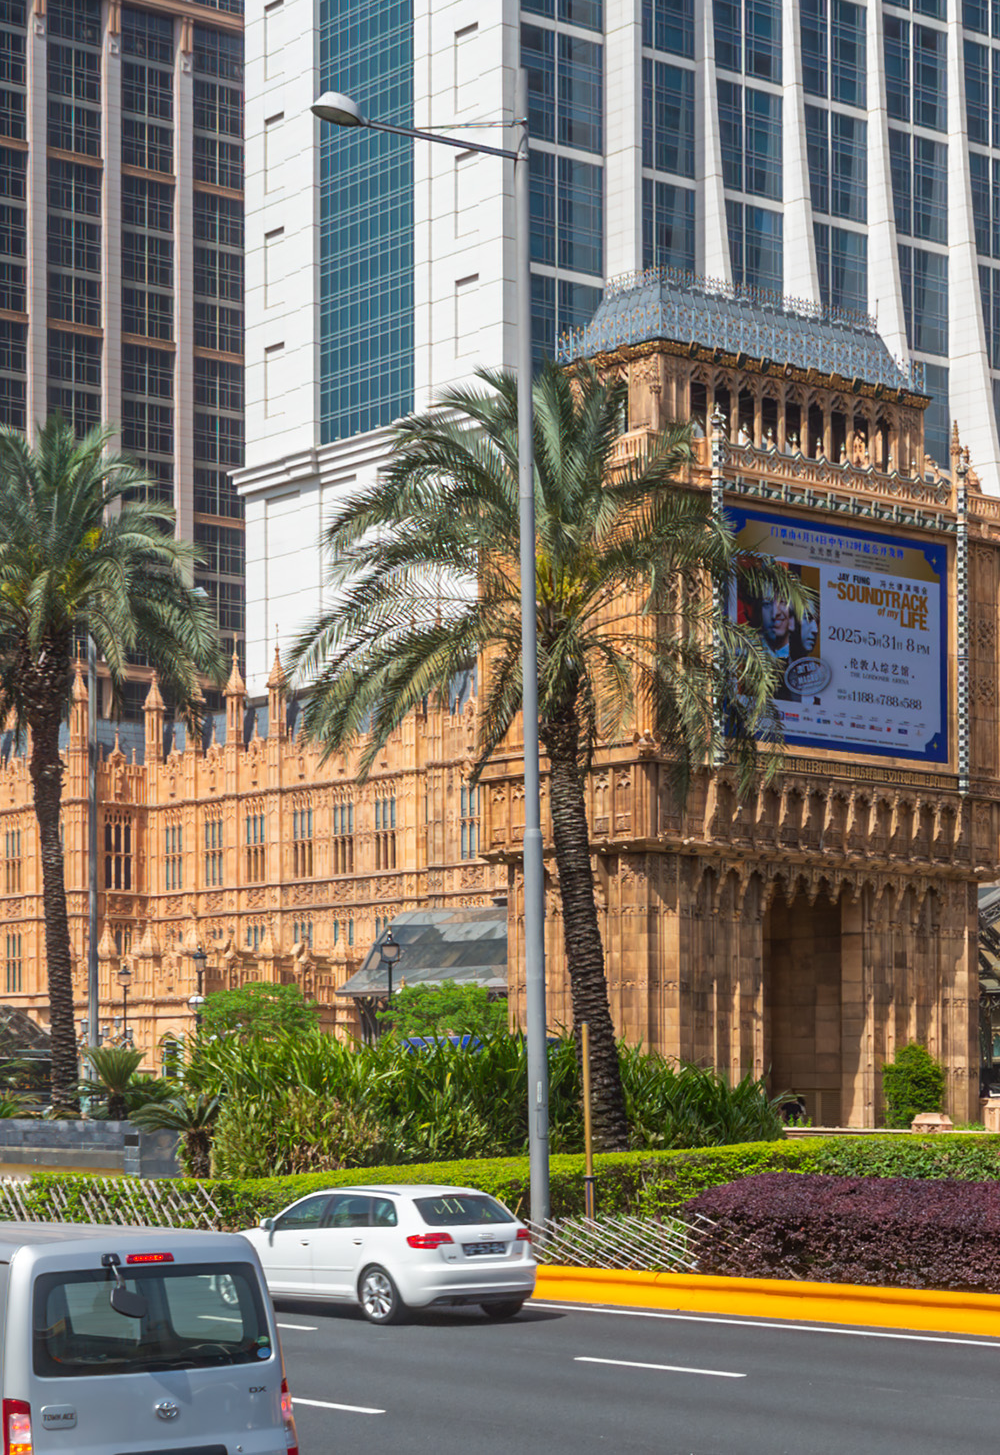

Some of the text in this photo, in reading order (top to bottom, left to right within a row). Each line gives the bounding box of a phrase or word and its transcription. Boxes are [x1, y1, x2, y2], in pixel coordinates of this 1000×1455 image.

[837, 573, 871, 586] JAY FUNG
[837, 582, 929, 614] SOUNDTRACK
[877, 607, 886, 619] of
[887, 609, 899, 621] my
[906, 638, 915, 653] 8
[916, 644, 930, 655] PM
[249, 1386, 267, 1394] DX
